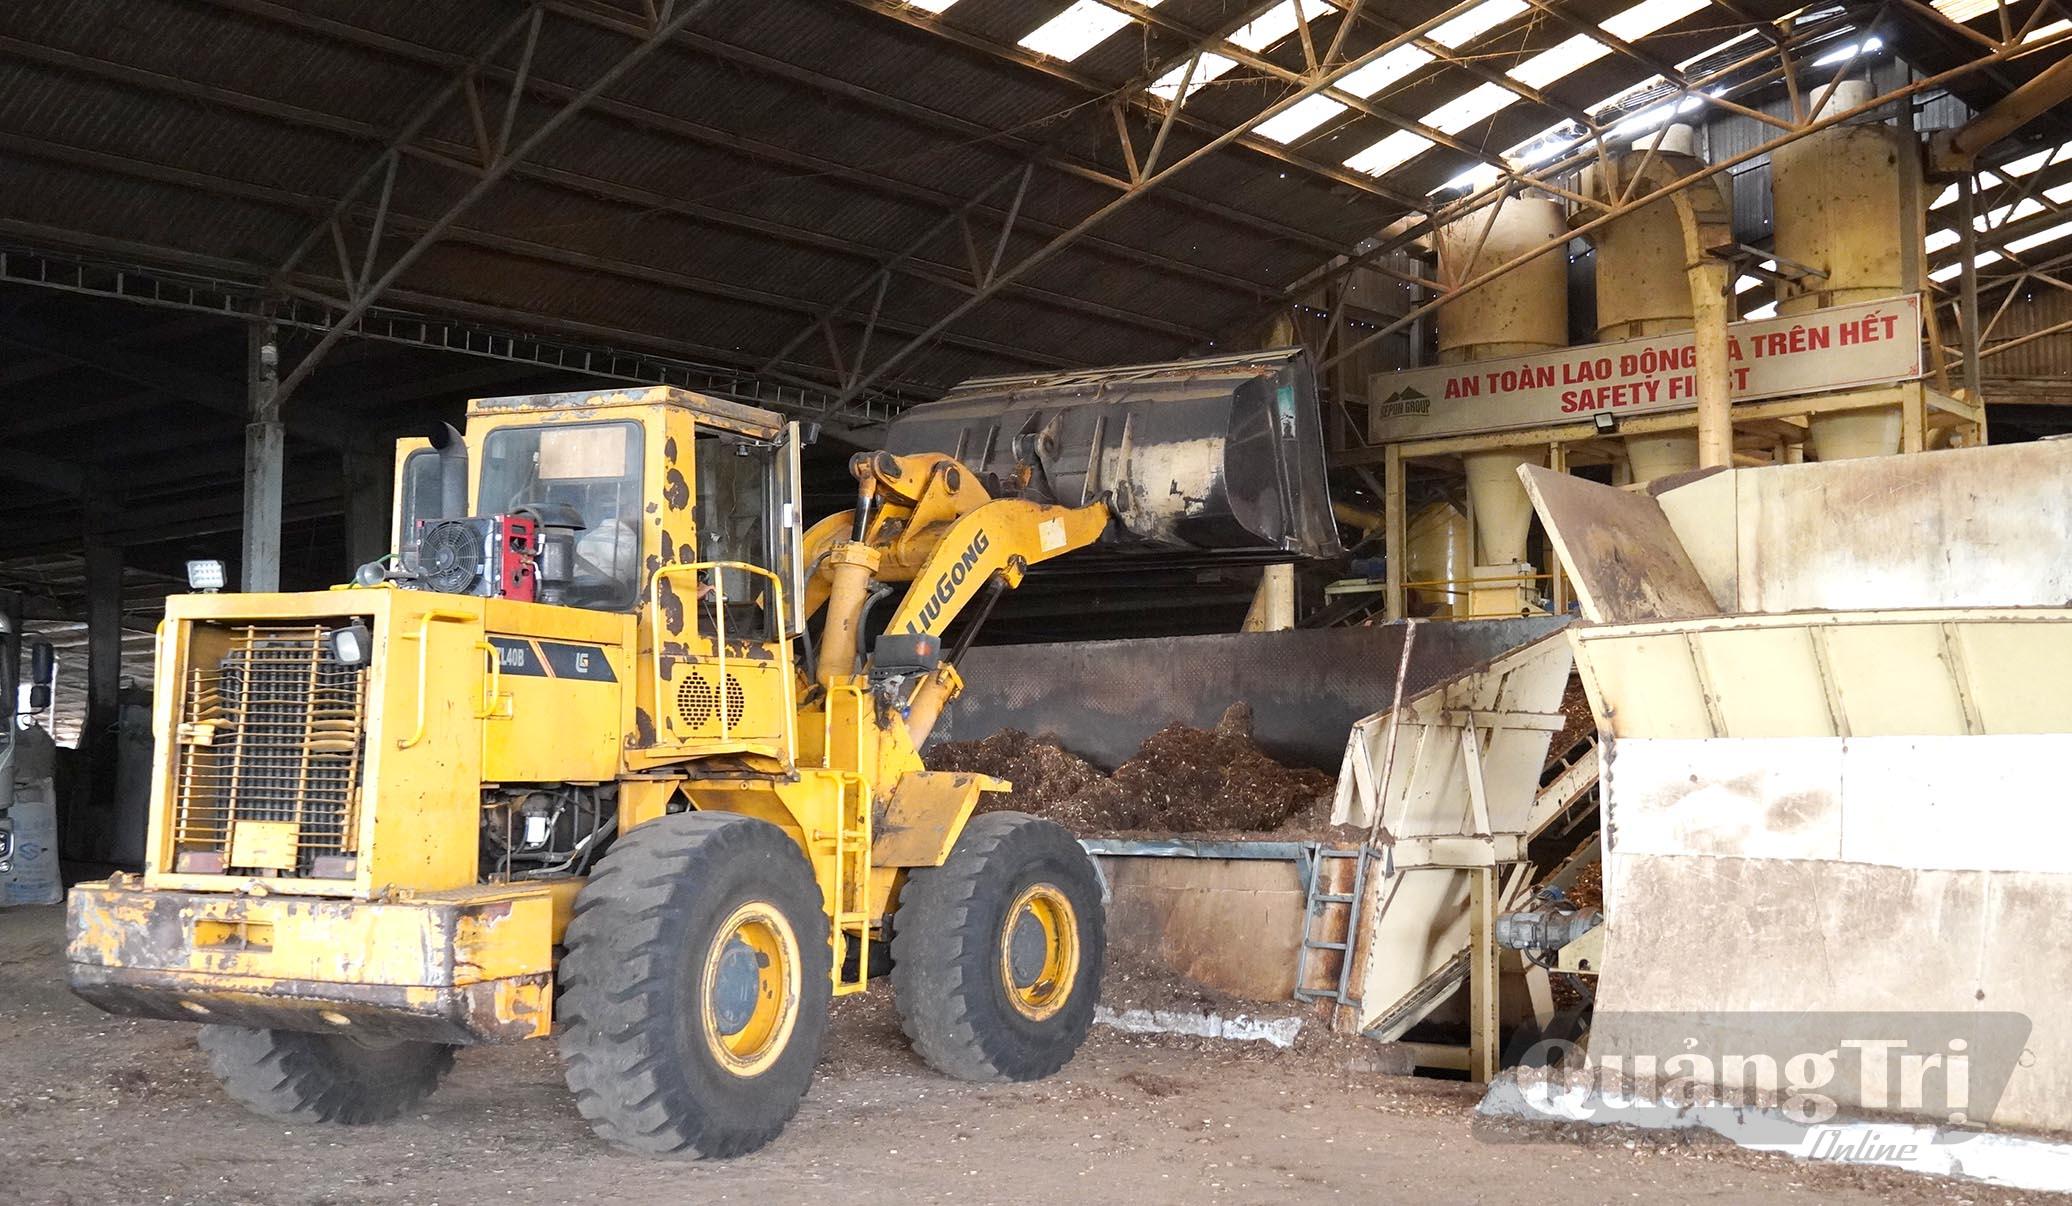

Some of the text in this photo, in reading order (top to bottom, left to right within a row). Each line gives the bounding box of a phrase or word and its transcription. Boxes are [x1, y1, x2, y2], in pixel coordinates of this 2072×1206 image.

[1444, 375, 1480, 400] AN
[1486, 364, 1555, 394] TOÀN
[1562, 358, 1613, 385] LAO
[1619, 345, 1697, 379] ĐỘNG
[1750, 324, 1830, 358] TRÊN
[1839, 309, 1898, 346] HẾT
[1405, 399, 1431, 414] GROUP
[1561, 367, 1750, 413] SAFETY FIT
